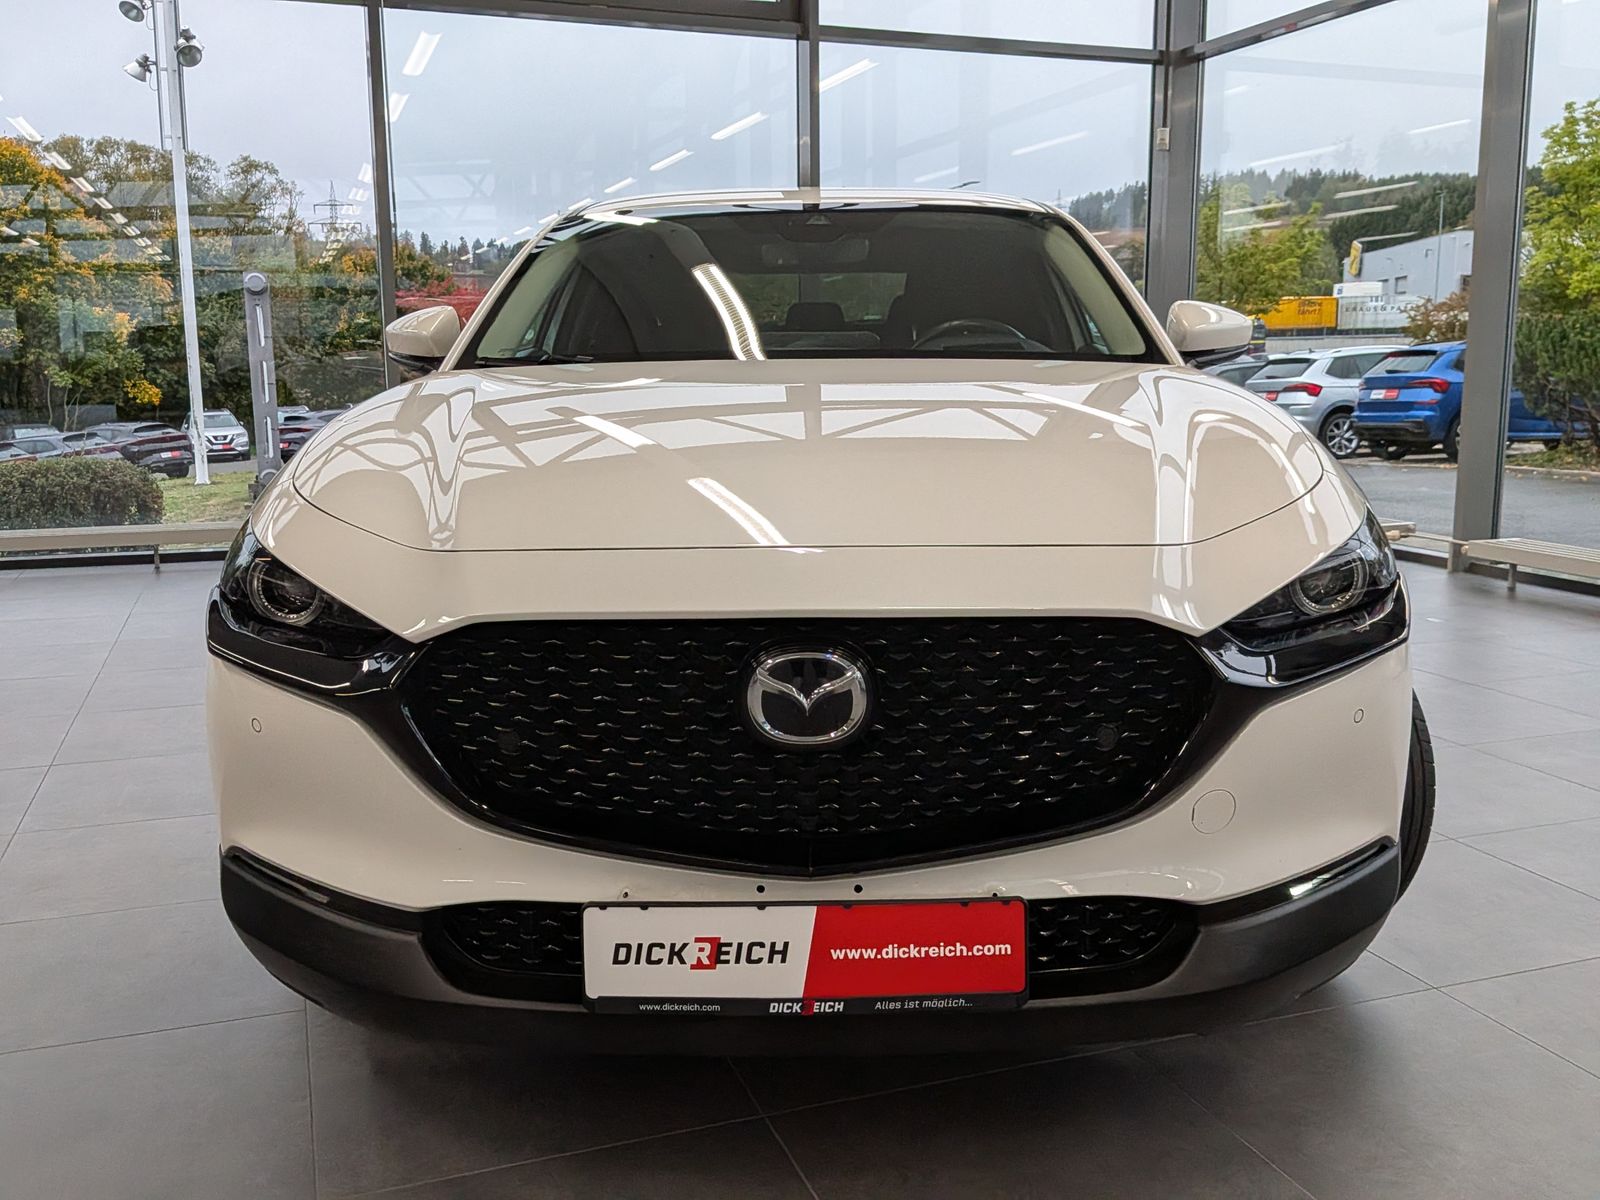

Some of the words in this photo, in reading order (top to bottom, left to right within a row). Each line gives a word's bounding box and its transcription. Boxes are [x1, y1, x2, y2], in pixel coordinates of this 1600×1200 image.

[612, 938, 790, 969] DICKREICH
[830, 942, 1012, 960] www.dickreich.com
[639, 1002, 721, 1013] www.dickreich.com
[769, 1001, 844, 1015] DICKEICH
[874, 1001, 902, 1010] Alles
[903, 999, 920, 1009] ist
